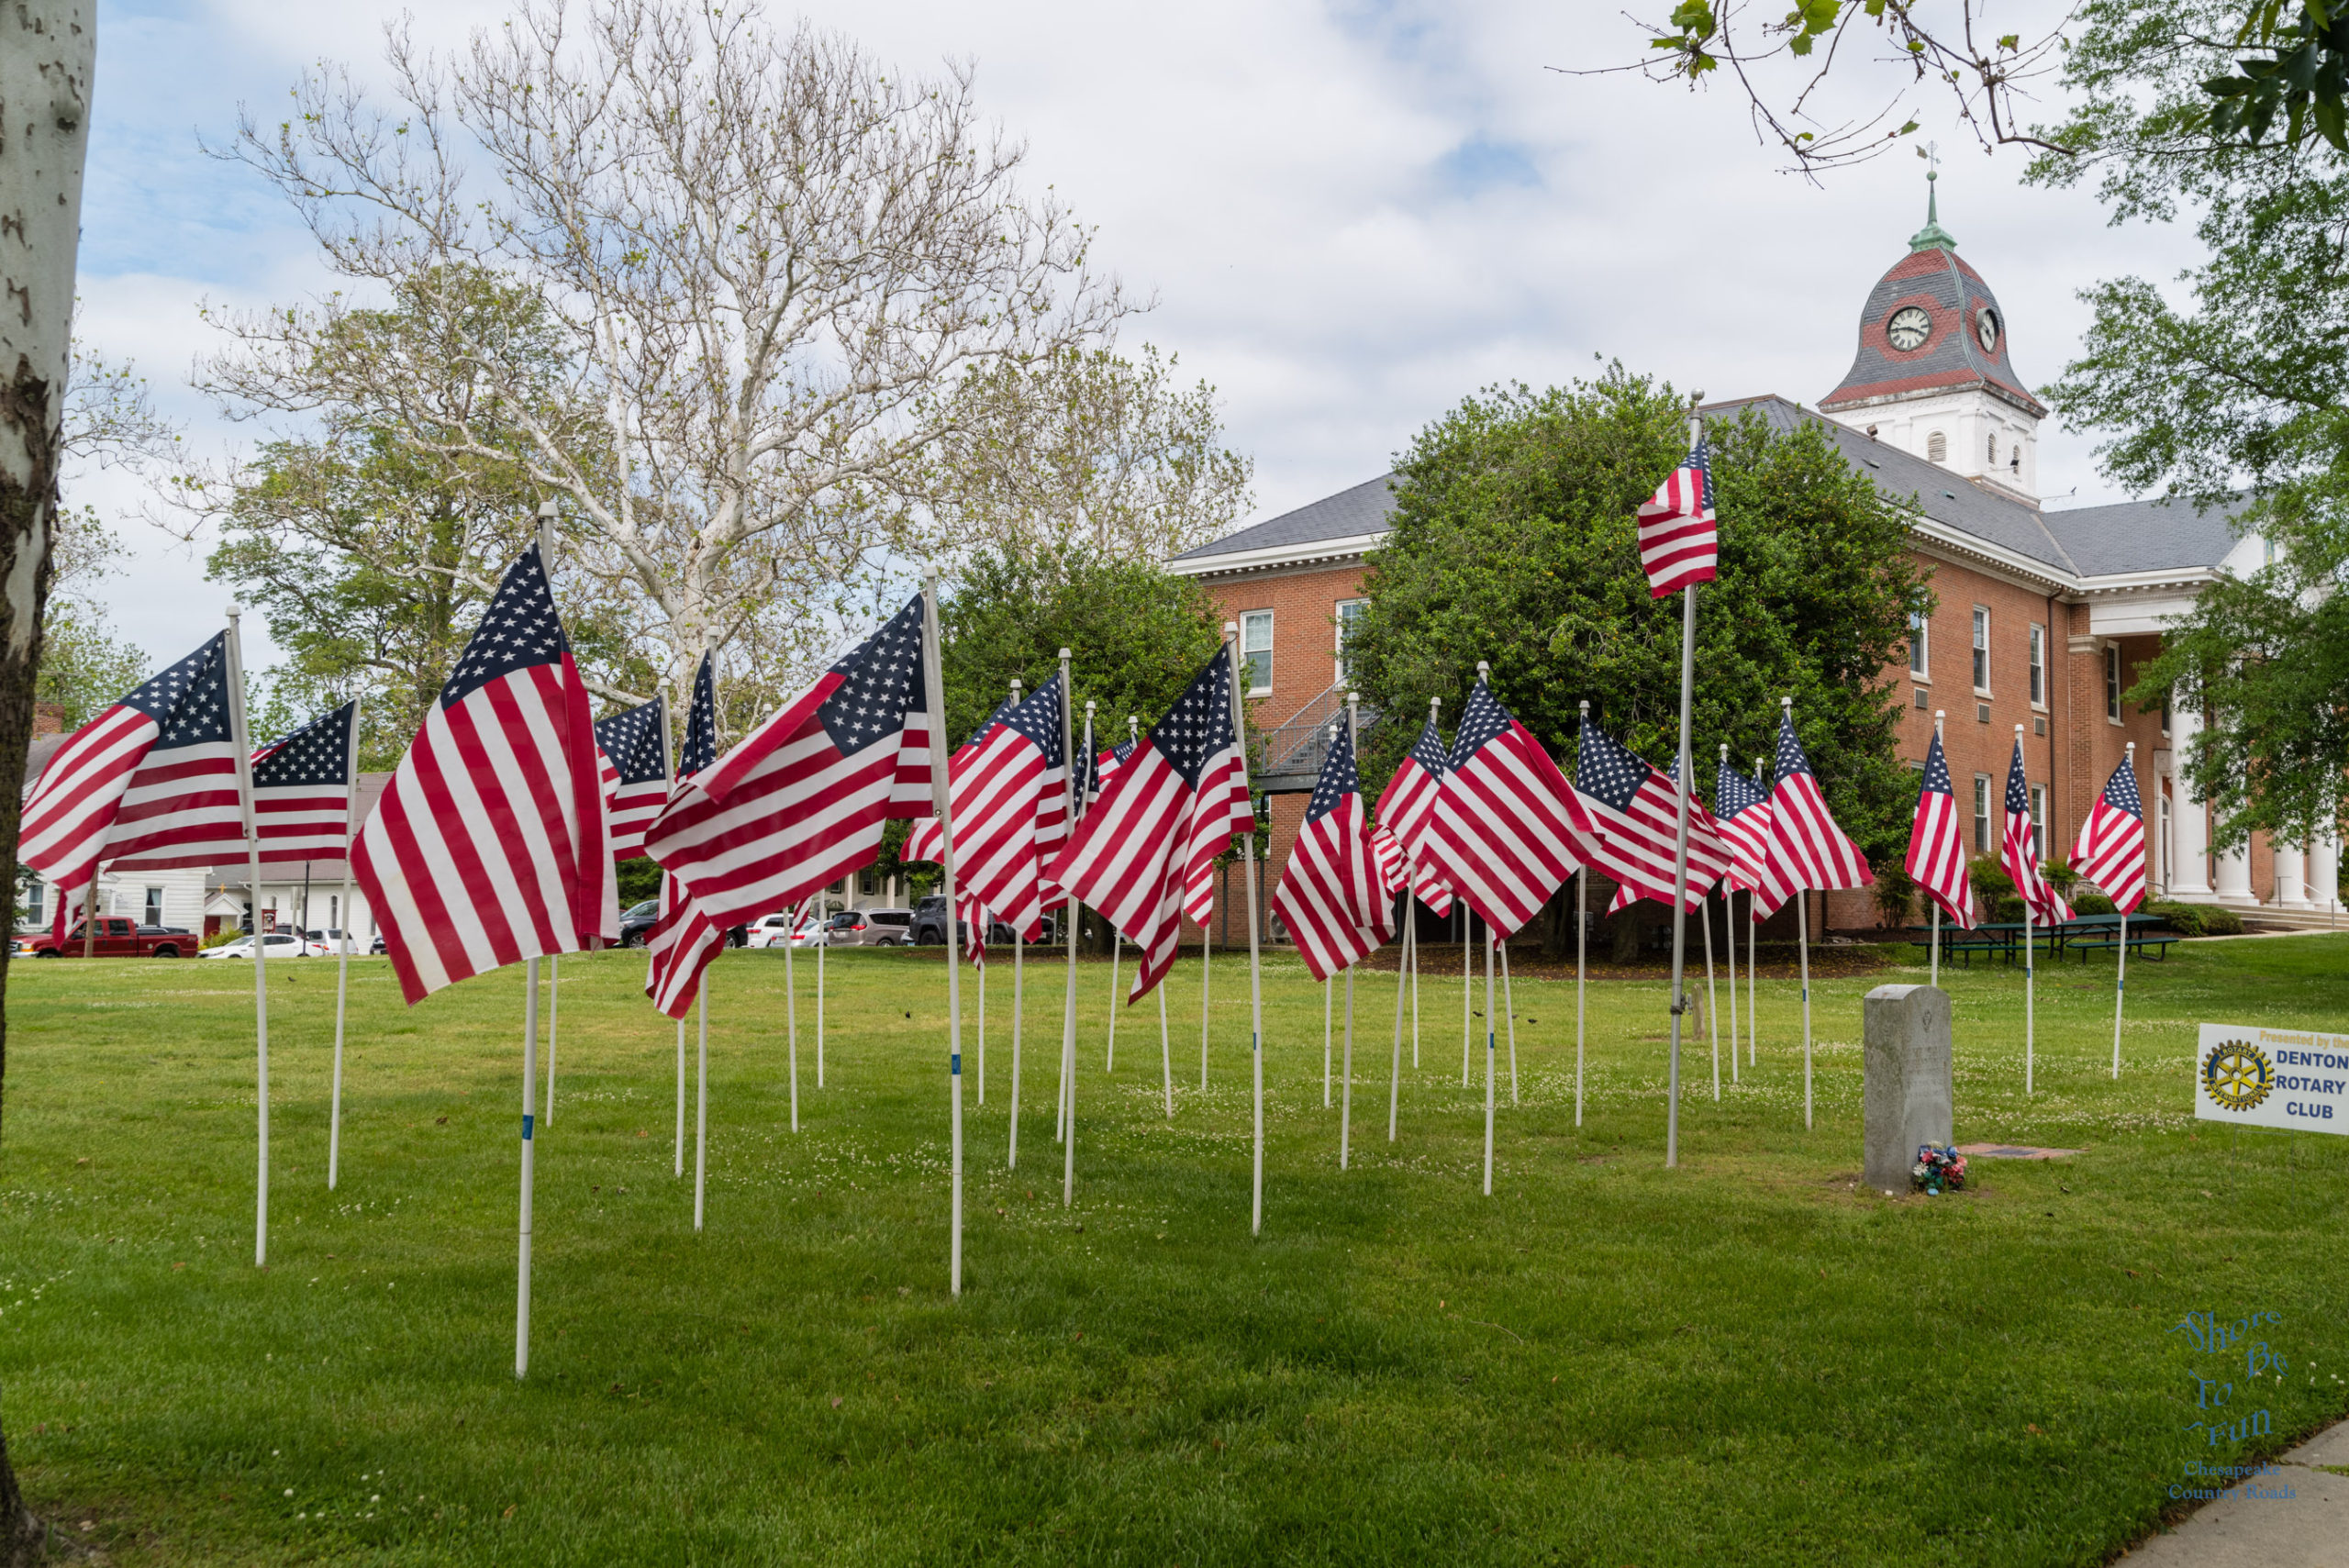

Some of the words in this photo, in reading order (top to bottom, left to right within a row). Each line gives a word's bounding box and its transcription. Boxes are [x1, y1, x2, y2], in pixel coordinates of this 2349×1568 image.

[2260, 1030, 2314, 1046] Presented
[2317, 1035, 2330, 1050] by
[2222, 1047, 2253, 1056] ROTARY
[2277, 1050, 2349, 1070] DENTON
[2211, 1083, 2262, 1102] INTERNATIONAL
[2276, 1075, 2346, 1095] ROTARY
[2286, 1102, 2333, 1119] CLUB
